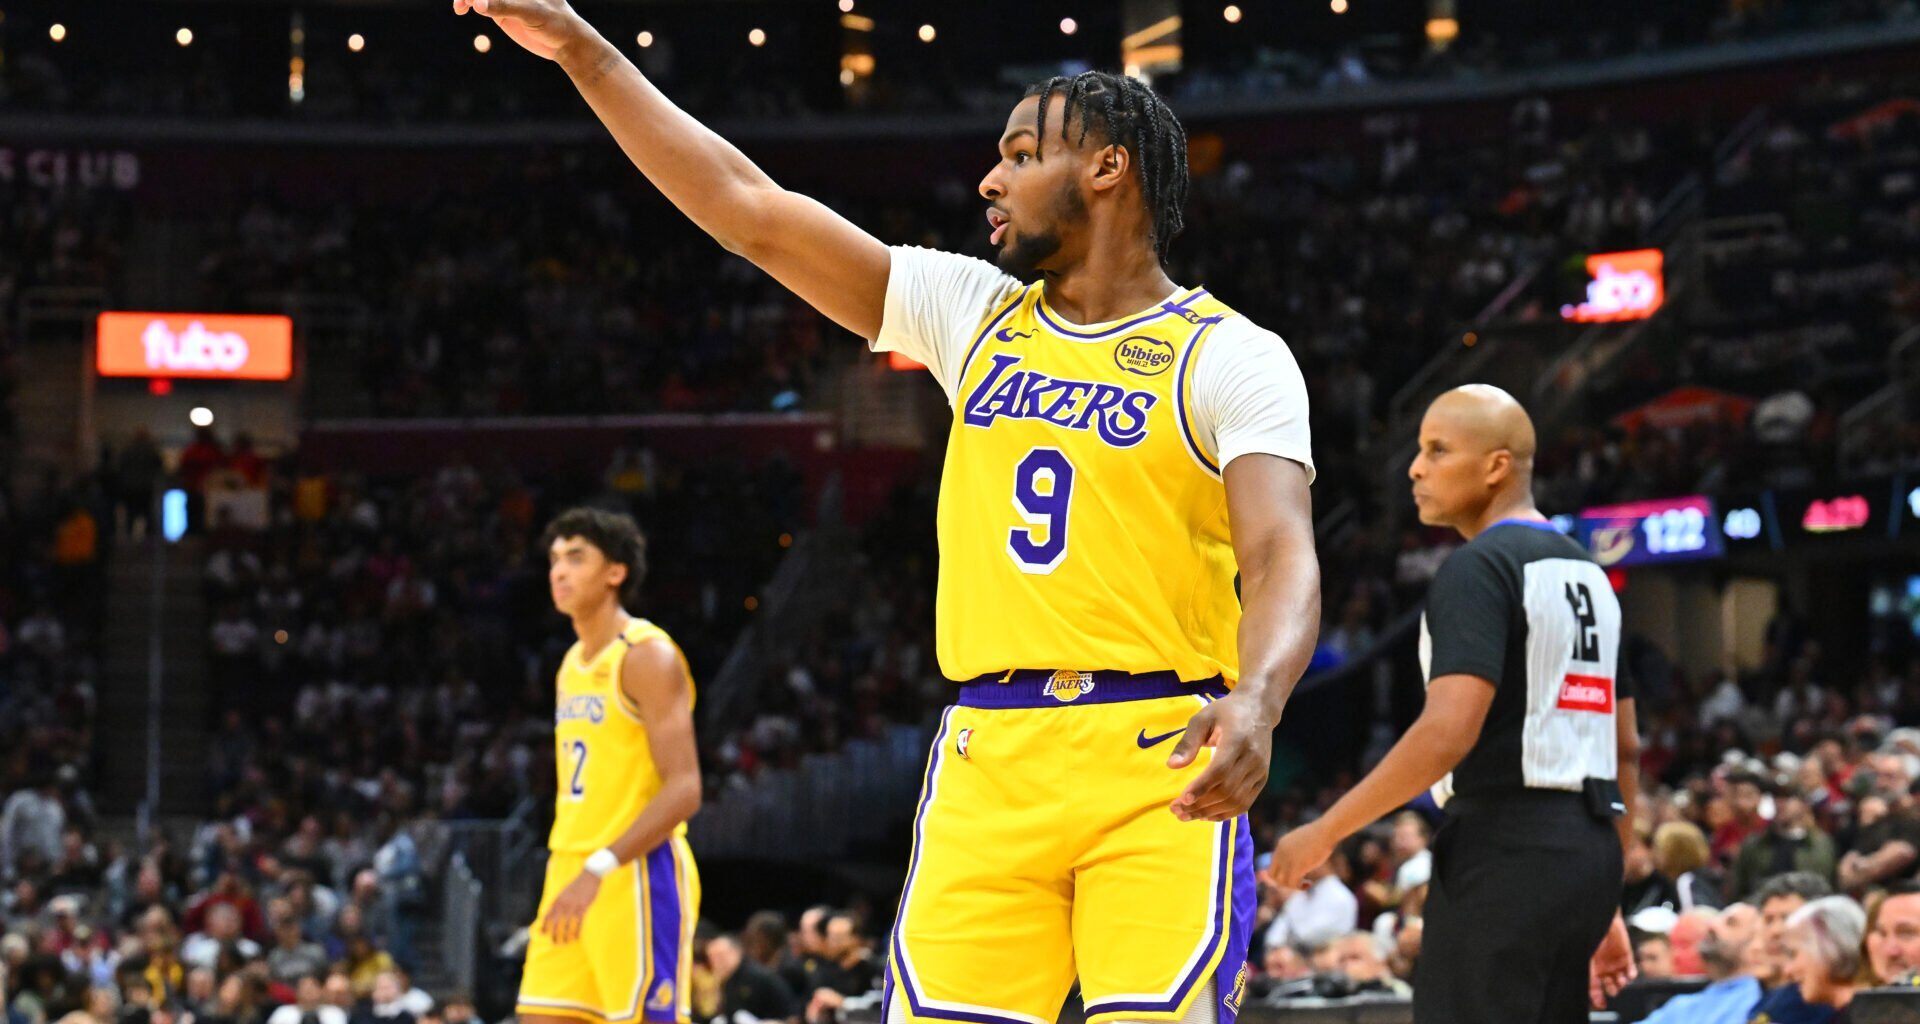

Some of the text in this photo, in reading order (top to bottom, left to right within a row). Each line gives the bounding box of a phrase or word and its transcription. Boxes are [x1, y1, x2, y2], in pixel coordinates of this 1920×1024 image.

[141, 319, 249, 371] fubo
[1121, 344, 1171, 366] bibigo
[964, 354, 1159, 448] LAKERS
[1007, 447, 1075, 574] 9
[1643, 507, 1705, 554] 122
[1045, 677, 1092, 694] LAKERS
